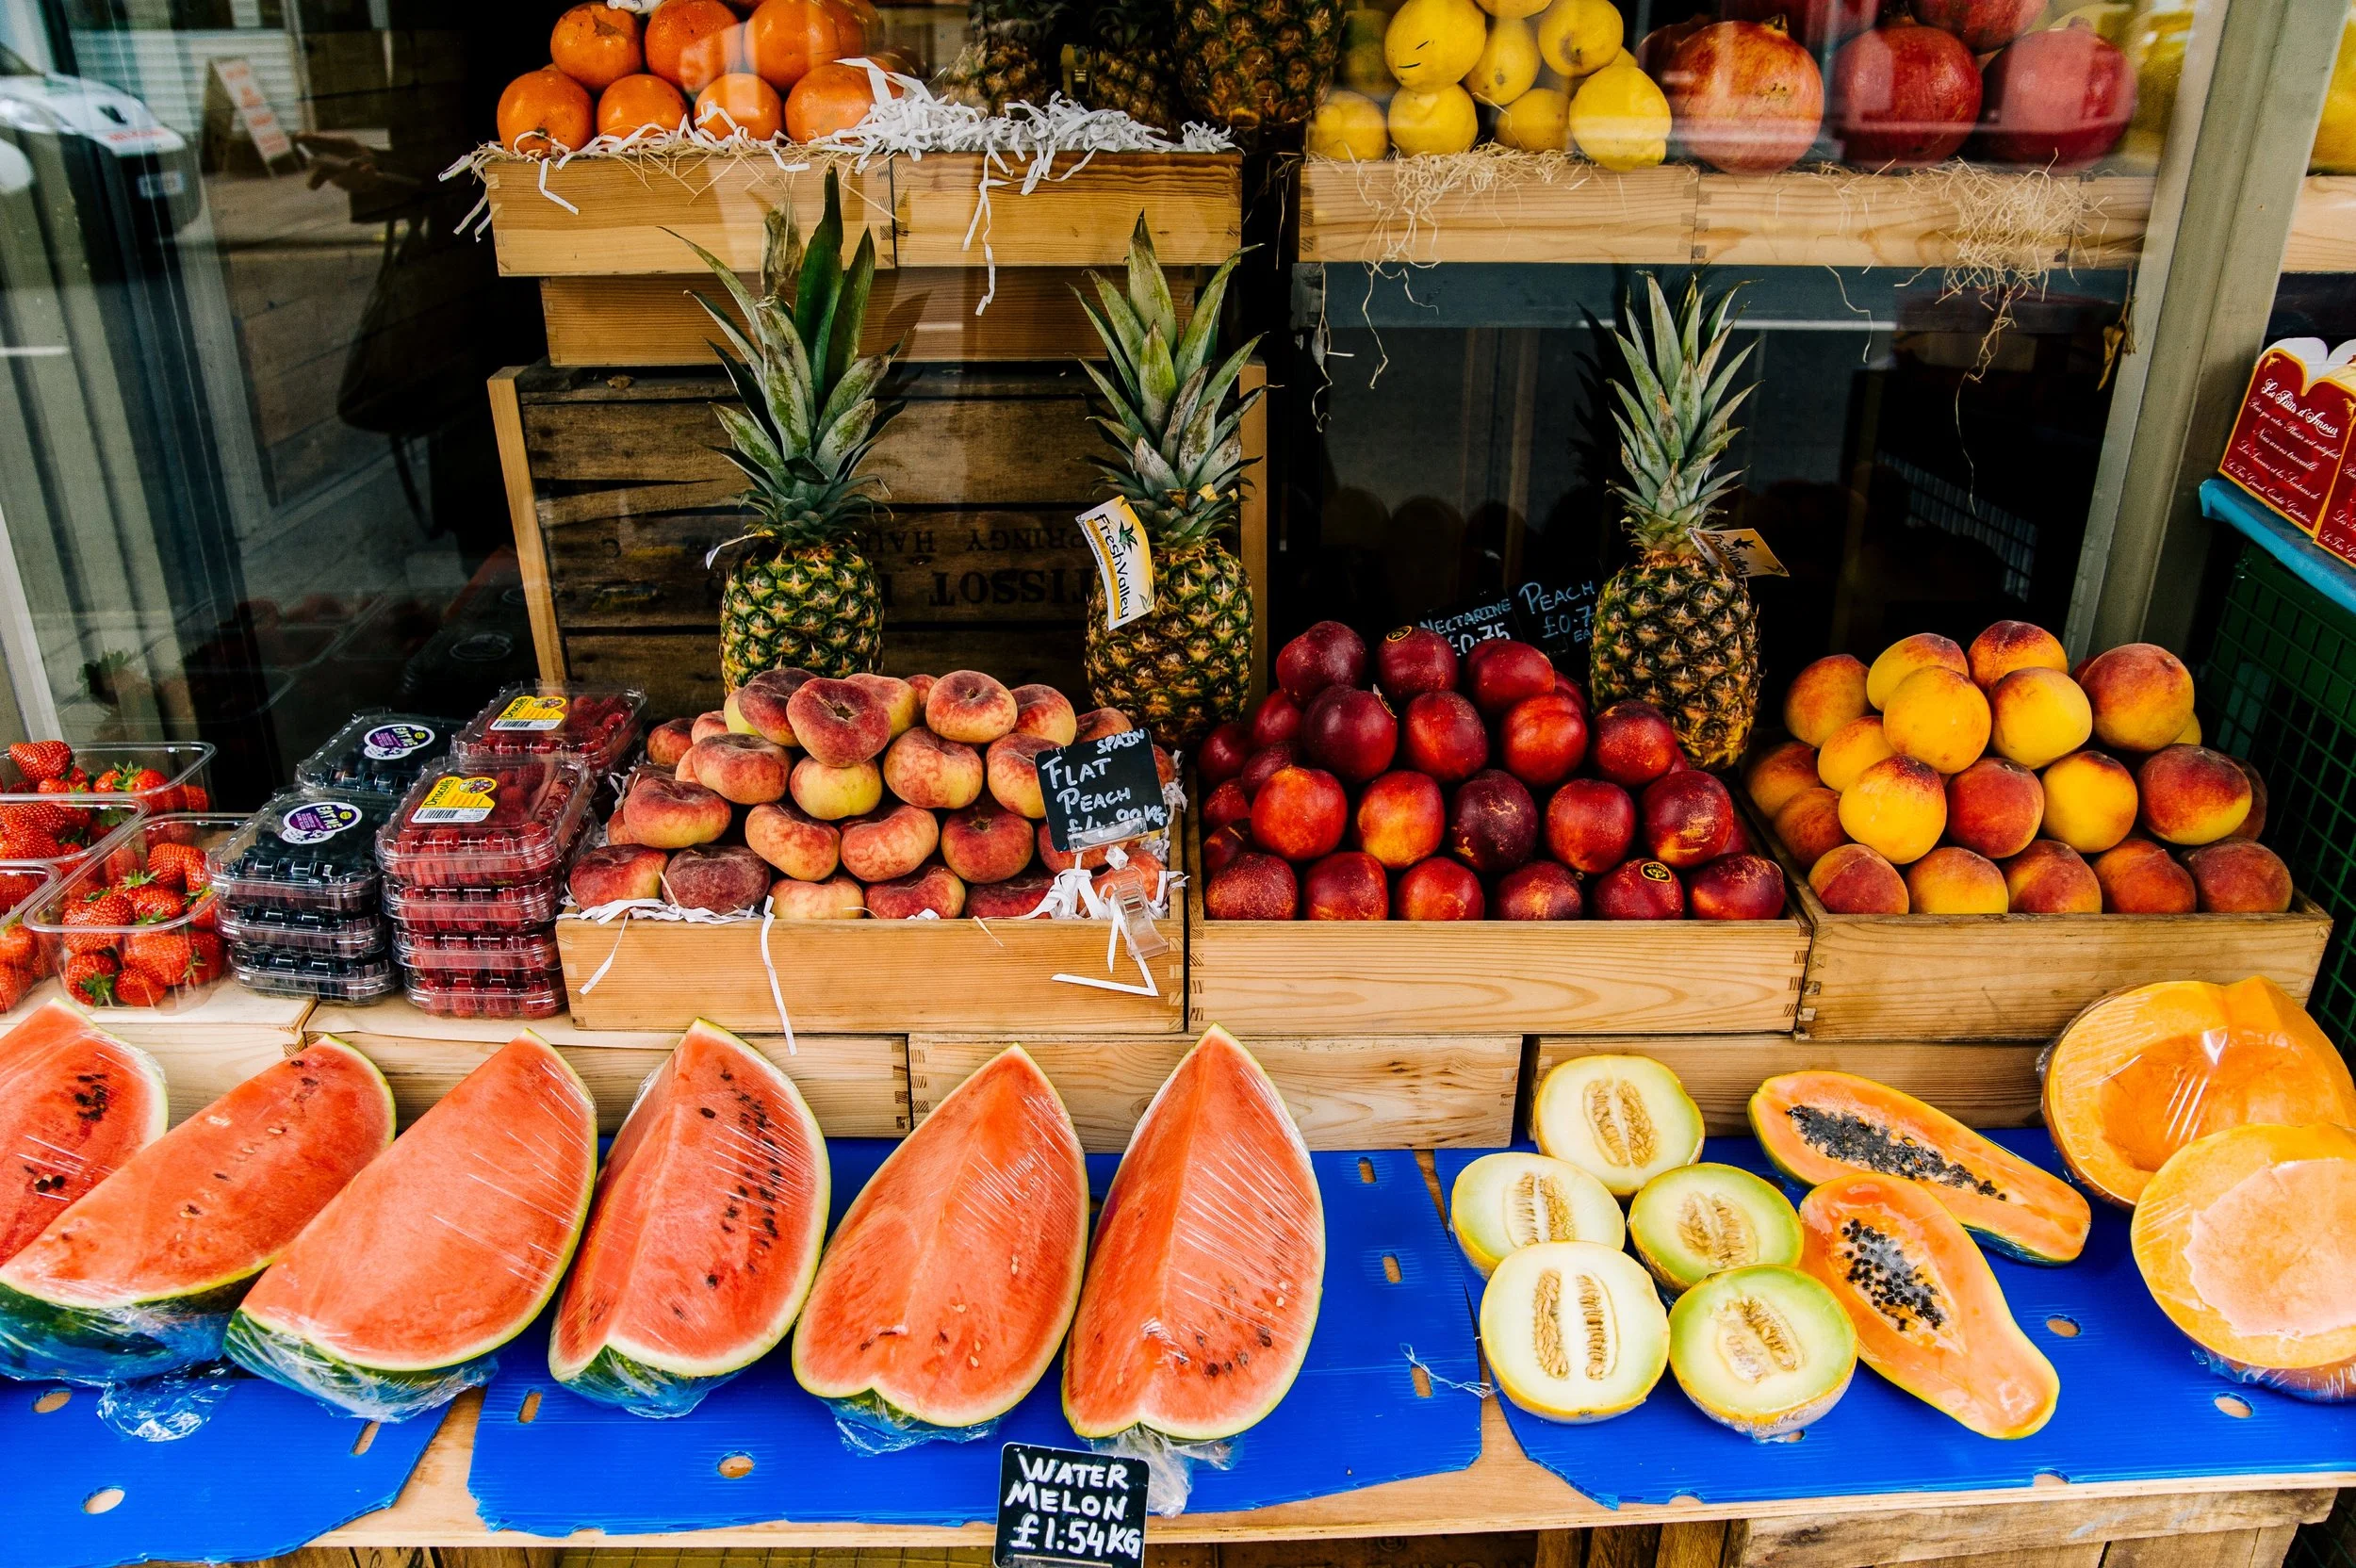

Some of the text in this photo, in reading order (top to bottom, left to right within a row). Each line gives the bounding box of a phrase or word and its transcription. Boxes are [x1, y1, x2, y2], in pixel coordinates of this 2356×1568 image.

[1094, 514, 1131, 620] FreshValley
[1518, 580, 1595, 614] PEACH
[1419, 598, 1512, 634] NECTARINE
[1542, 605, 1595, 639] £0.7
[1096, 728, 1145, 755] SPAIN
[1041, 756, 1111, 789] FLAT
[1056, 787, 1131, 814] PEACH
[1018, 1453, 1129, 1490] WATER
[1005, 1480, 1128, 1521] MELON
